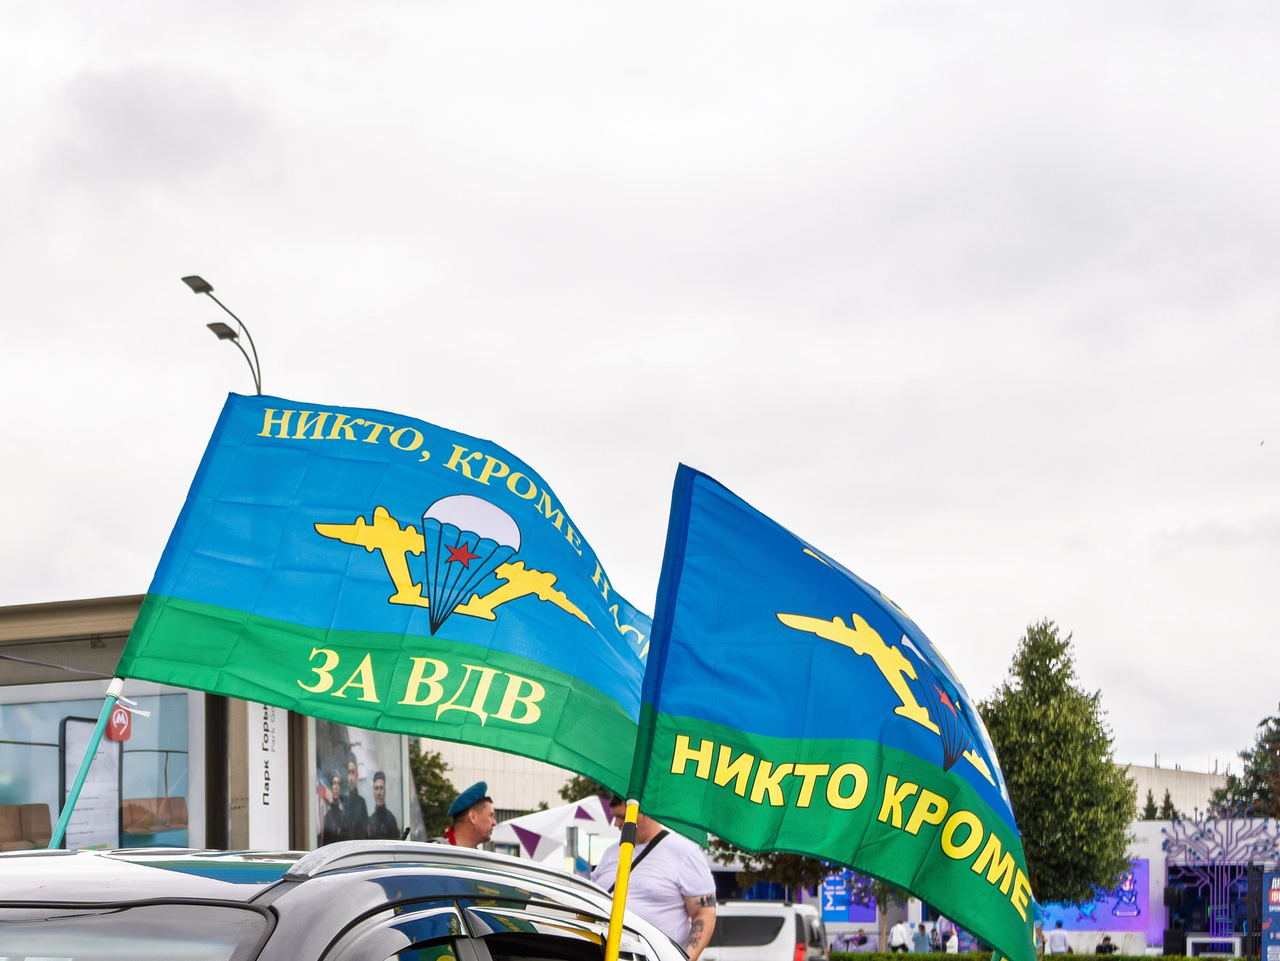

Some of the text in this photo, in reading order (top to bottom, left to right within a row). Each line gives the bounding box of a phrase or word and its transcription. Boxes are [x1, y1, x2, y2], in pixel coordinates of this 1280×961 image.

[257, 408, 431, 462] НИКТО,
[443, 444, 582, 556] КРОМЕ
[297, 647, 546, 726] ЗА ВДВ
[262, 759, 270, 806] Парк
[670, 734, 1033, 922] НИКТО КРОМЕ
